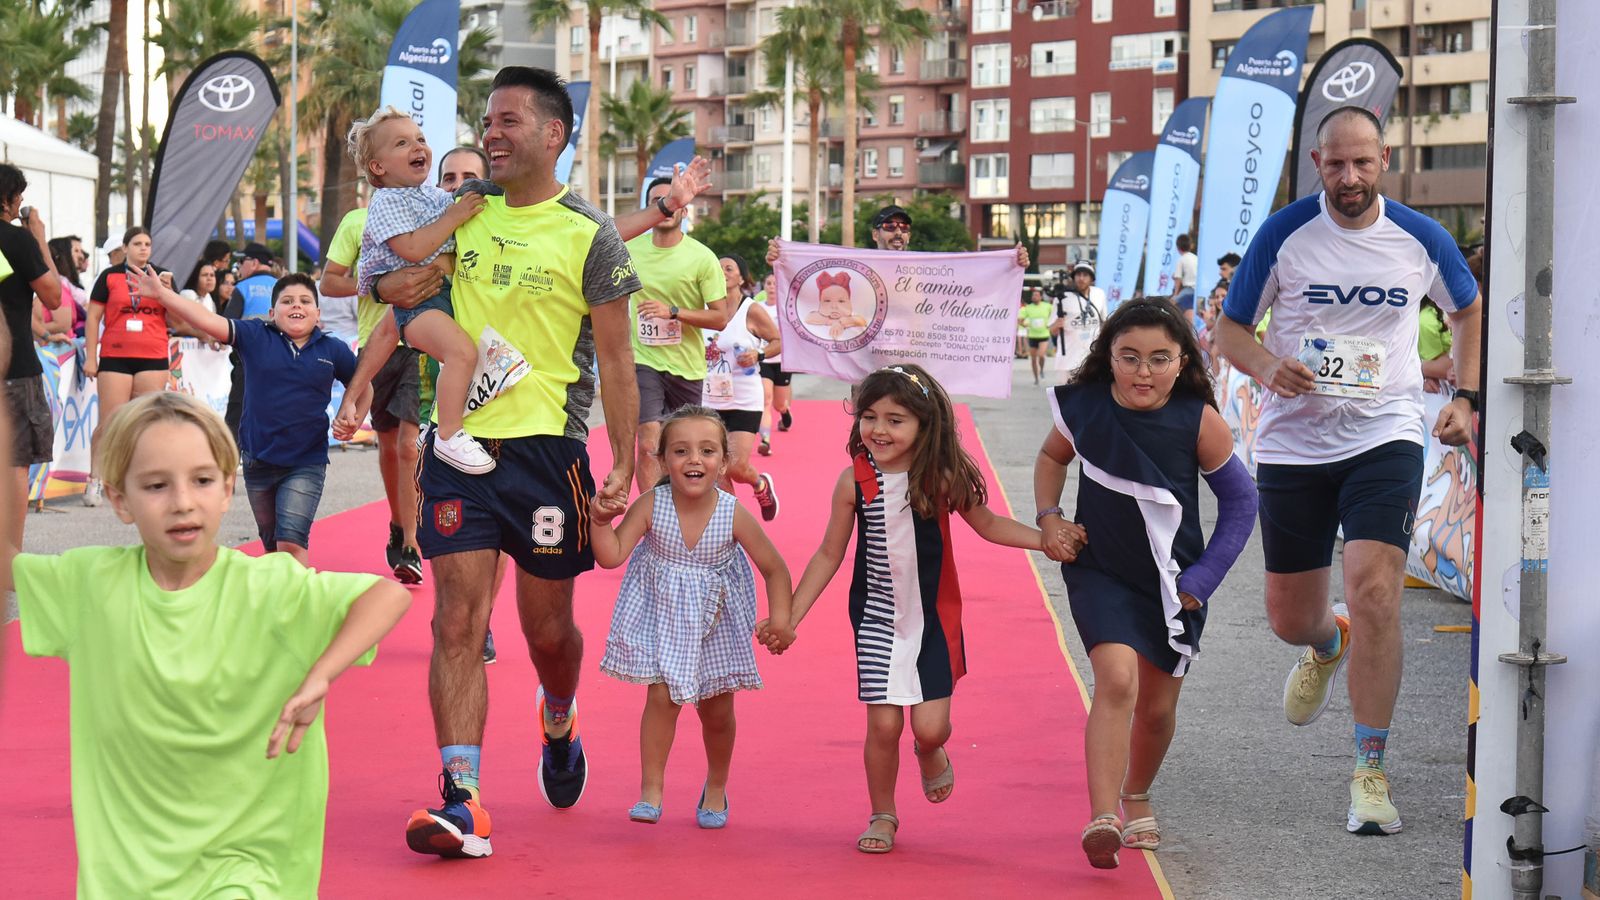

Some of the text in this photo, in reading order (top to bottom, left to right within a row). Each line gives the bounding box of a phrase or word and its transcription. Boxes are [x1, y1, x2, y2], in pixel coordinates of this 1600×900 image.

[408, 45, 429, 53] Puerto
[398, 52, 438, 64] Algeciras
[1248, 56, 1272, 66] Puerto
[1236, 63, 1281, 76] Algeciras
[193, 123, 256, 142] TOMAX
[1234, 102, 1263, 247] Sergeyco
[1162, 163, 1181, 266] Sergeyco
[1113, 203, 1131, 283] Sergeyco
[895, 264, 954, 277] Asociación
[894, 276, 975, 297] El camino
[1303, 284, 1409, 307] EVOS
[914, 298, 1010, 320] de Valentina
[640, 323, 659, 337] 331
[932, 323, 965, 332] Colabora
[906, 330, 925, 338] 2100
[927, 332, 947, 341] 8508
[949, 333, 969, 342] 5102
[910, 339, 942, 348] Concepto
[872, 346, 928, 358] Investigación
[930, 352, 970, 362] mutacion
[531, 505, 565, 546] 8
[532, 546, 563, 555] adidas
